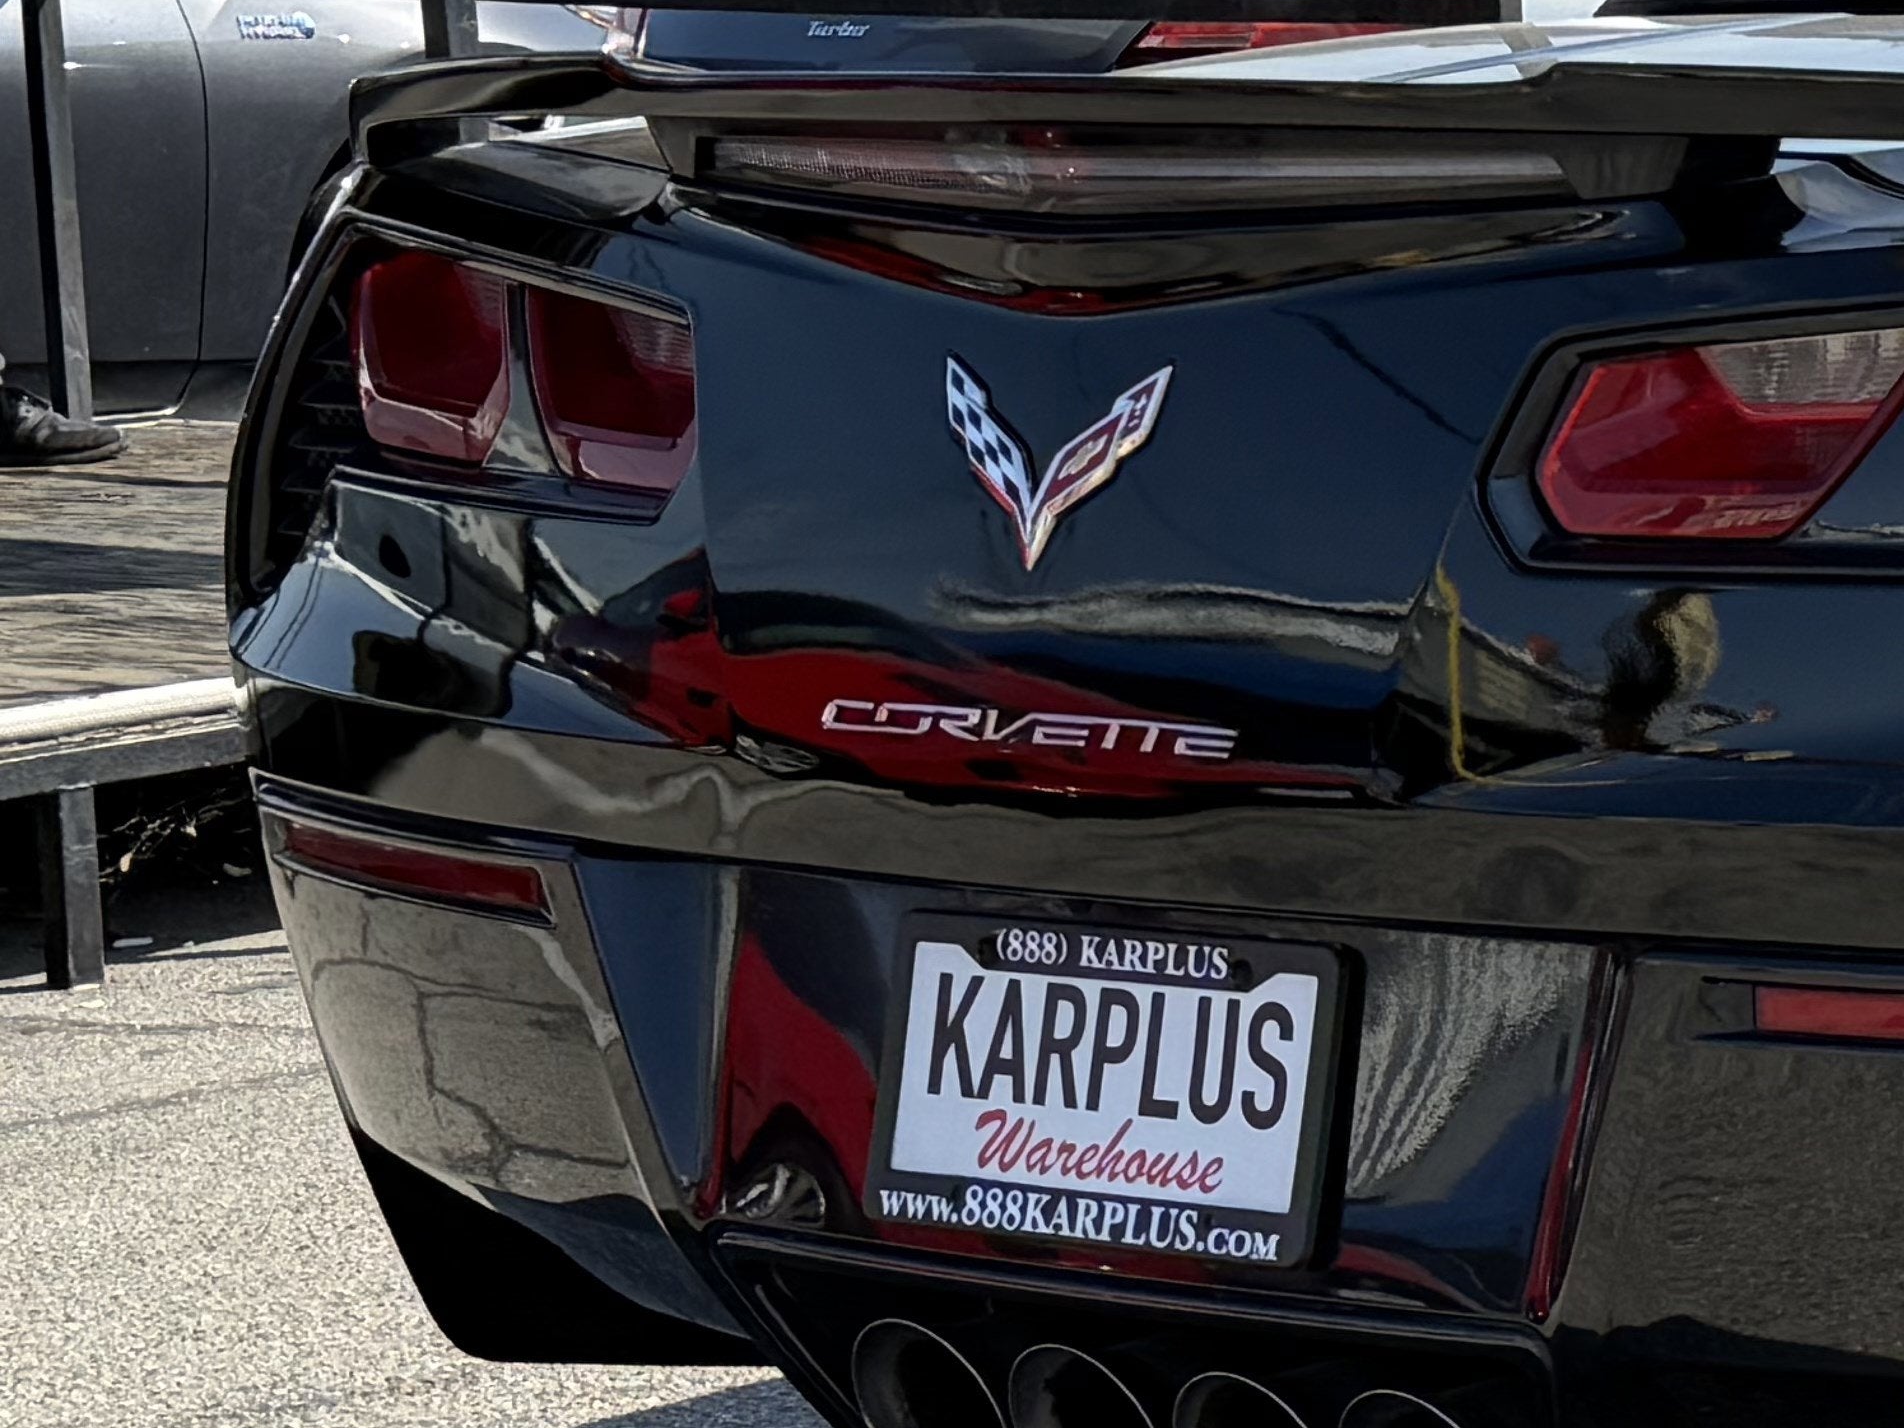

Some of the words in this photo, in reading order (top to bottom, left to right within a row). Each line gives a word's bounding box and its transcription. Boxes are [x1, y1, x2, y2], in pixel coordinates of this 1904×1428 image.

[821, 698, 1240, 759] CORVETTE
[996, 928, 1068, 966] (888)
[1079, 935, 1229, 980] KARPLUS
[927, 972, 1295, 1130] KARPLUS
[974, 1109, 1224, 1194] Warehouse
